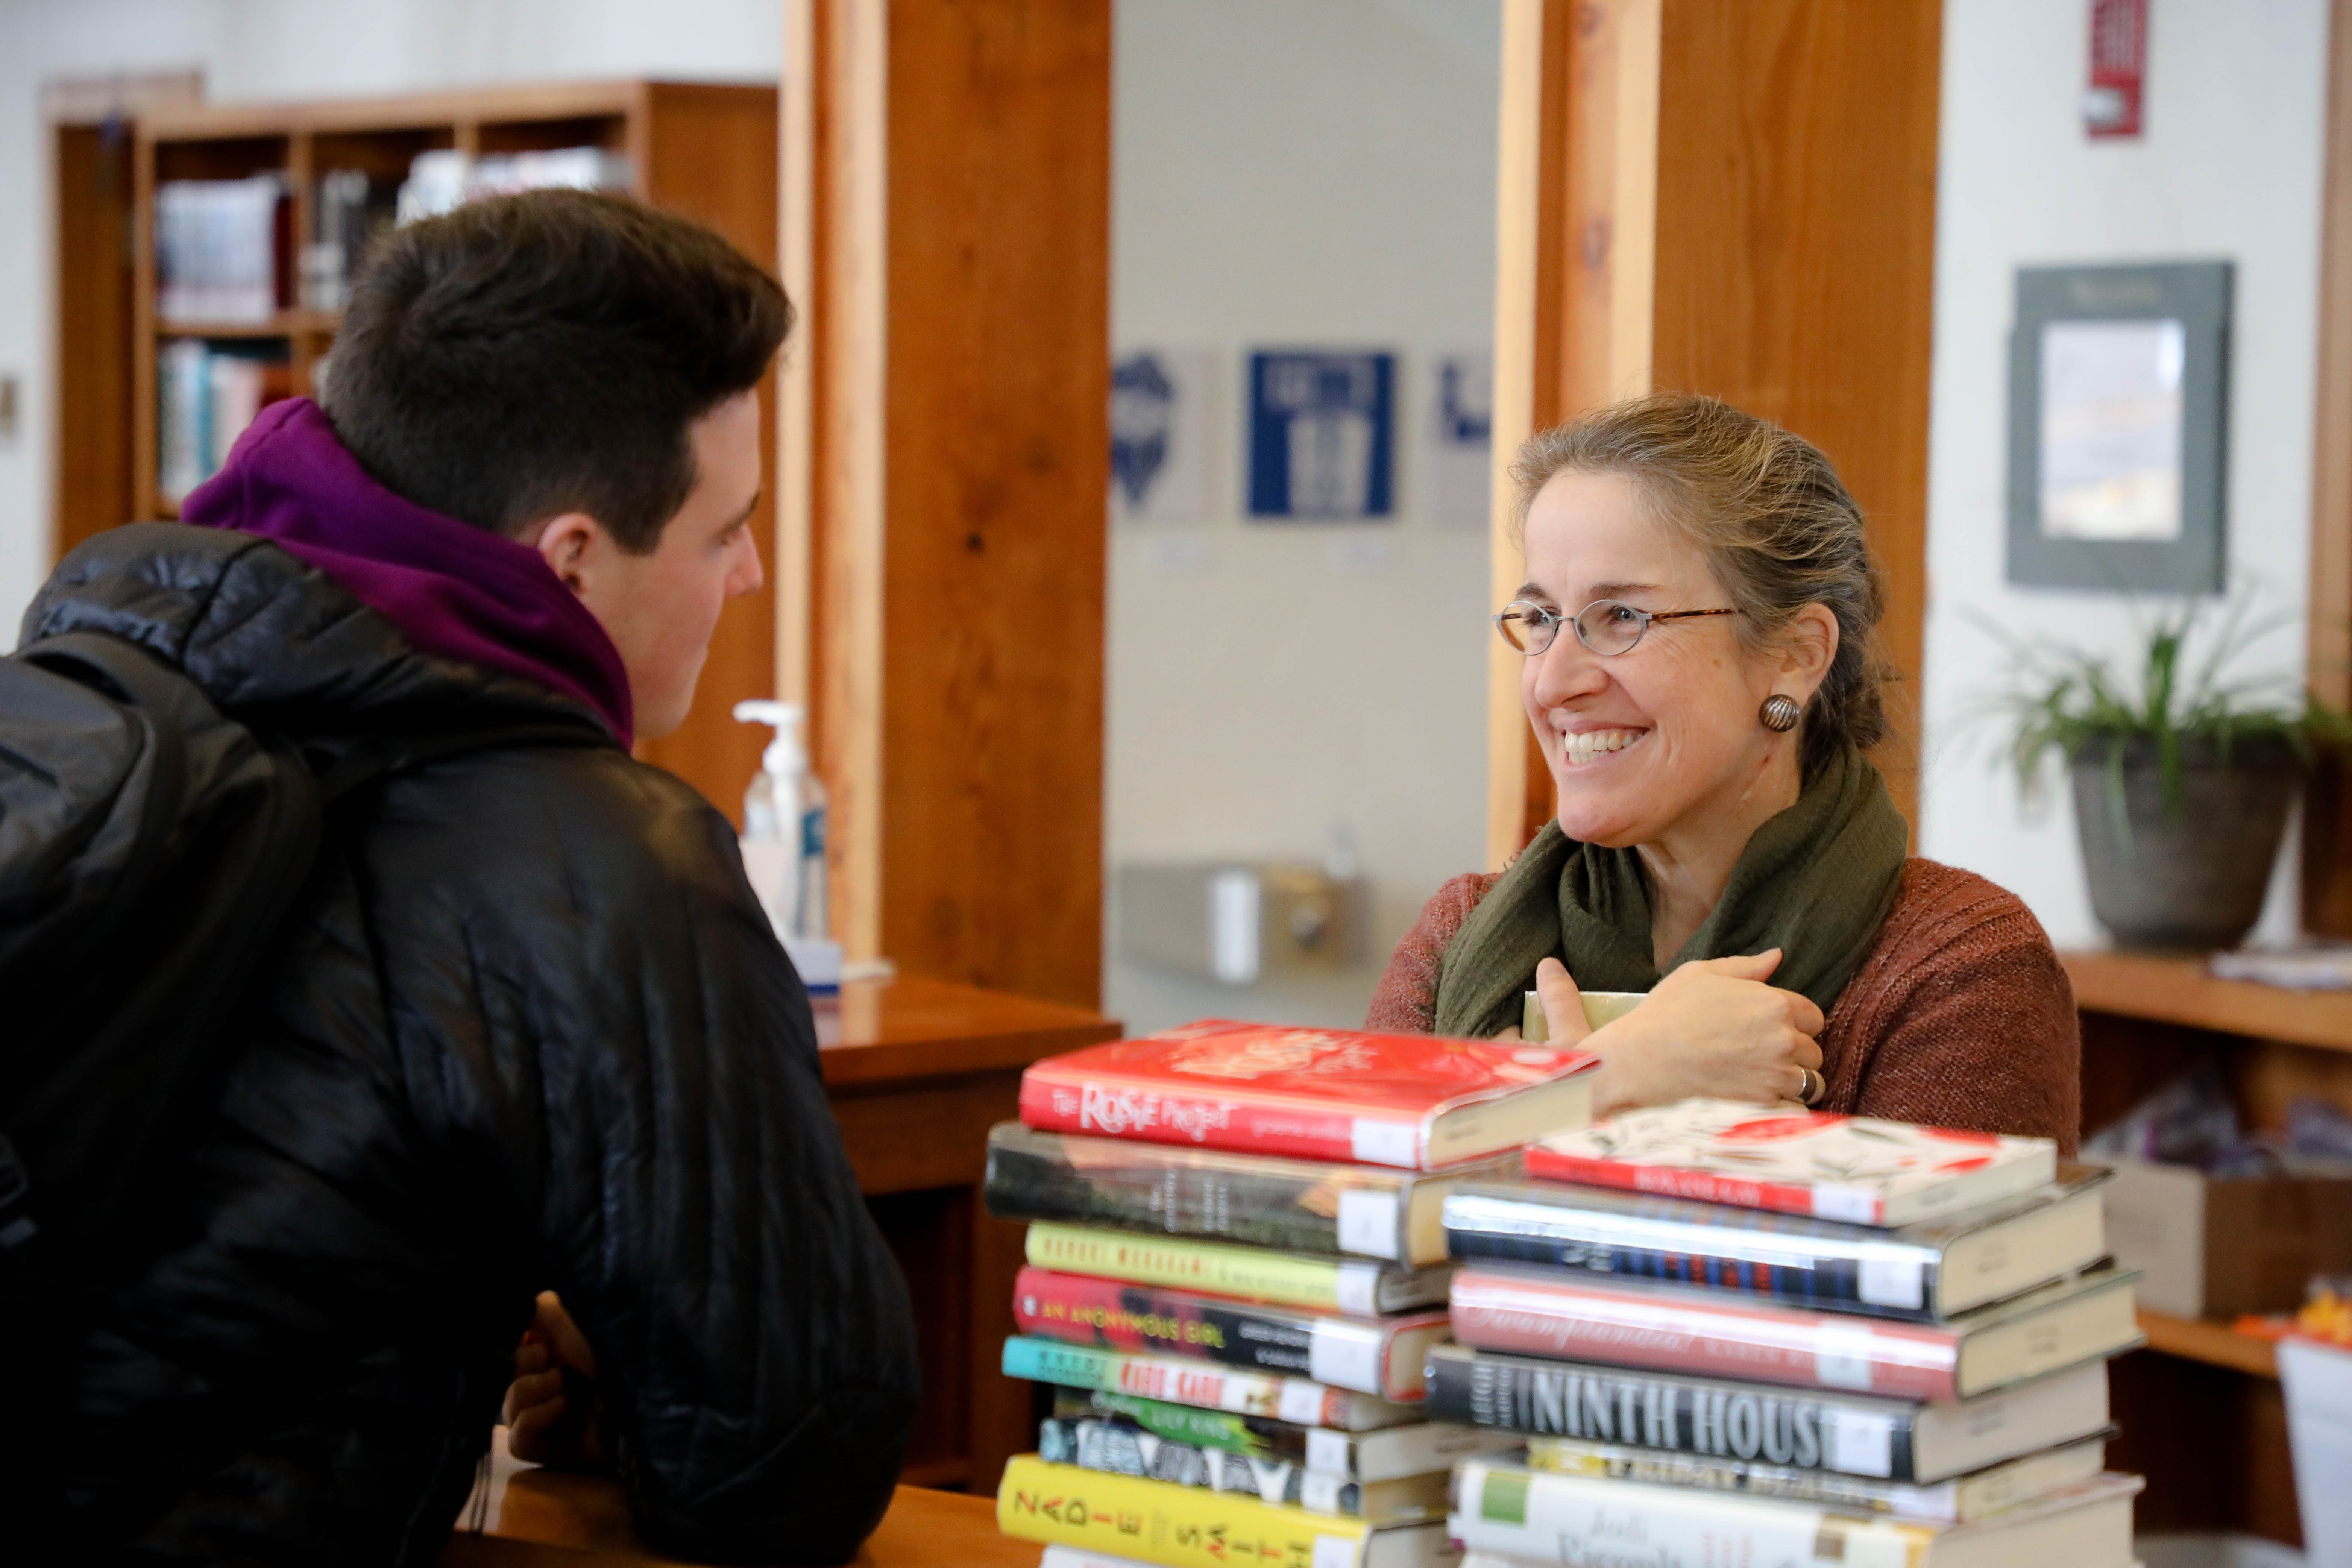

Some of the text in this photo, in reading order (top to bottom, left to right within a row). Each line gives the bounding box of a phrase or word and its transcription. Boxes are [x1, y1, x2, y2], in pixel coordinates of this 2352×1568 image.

[1080, 1081, 1159, 1133] ROSIE
[1161, 1099, 1240, 1142] PROJECT
[1042, 1301, 1067, 1318] AN
[1071, 1304, 1181, 1341] ANONYMOUS
[1183, 1319, 1228, 1349] GIRL
[1152, 1406, 1187, 1430] LILY
[1188, 1413, 1231, 1440] KING
[1531, 1366, 1680, 1449] NINTH
[1014, 1489, 1143, 1536] ZADIE
[1176, 1520, 1312, 1568] SMITH
